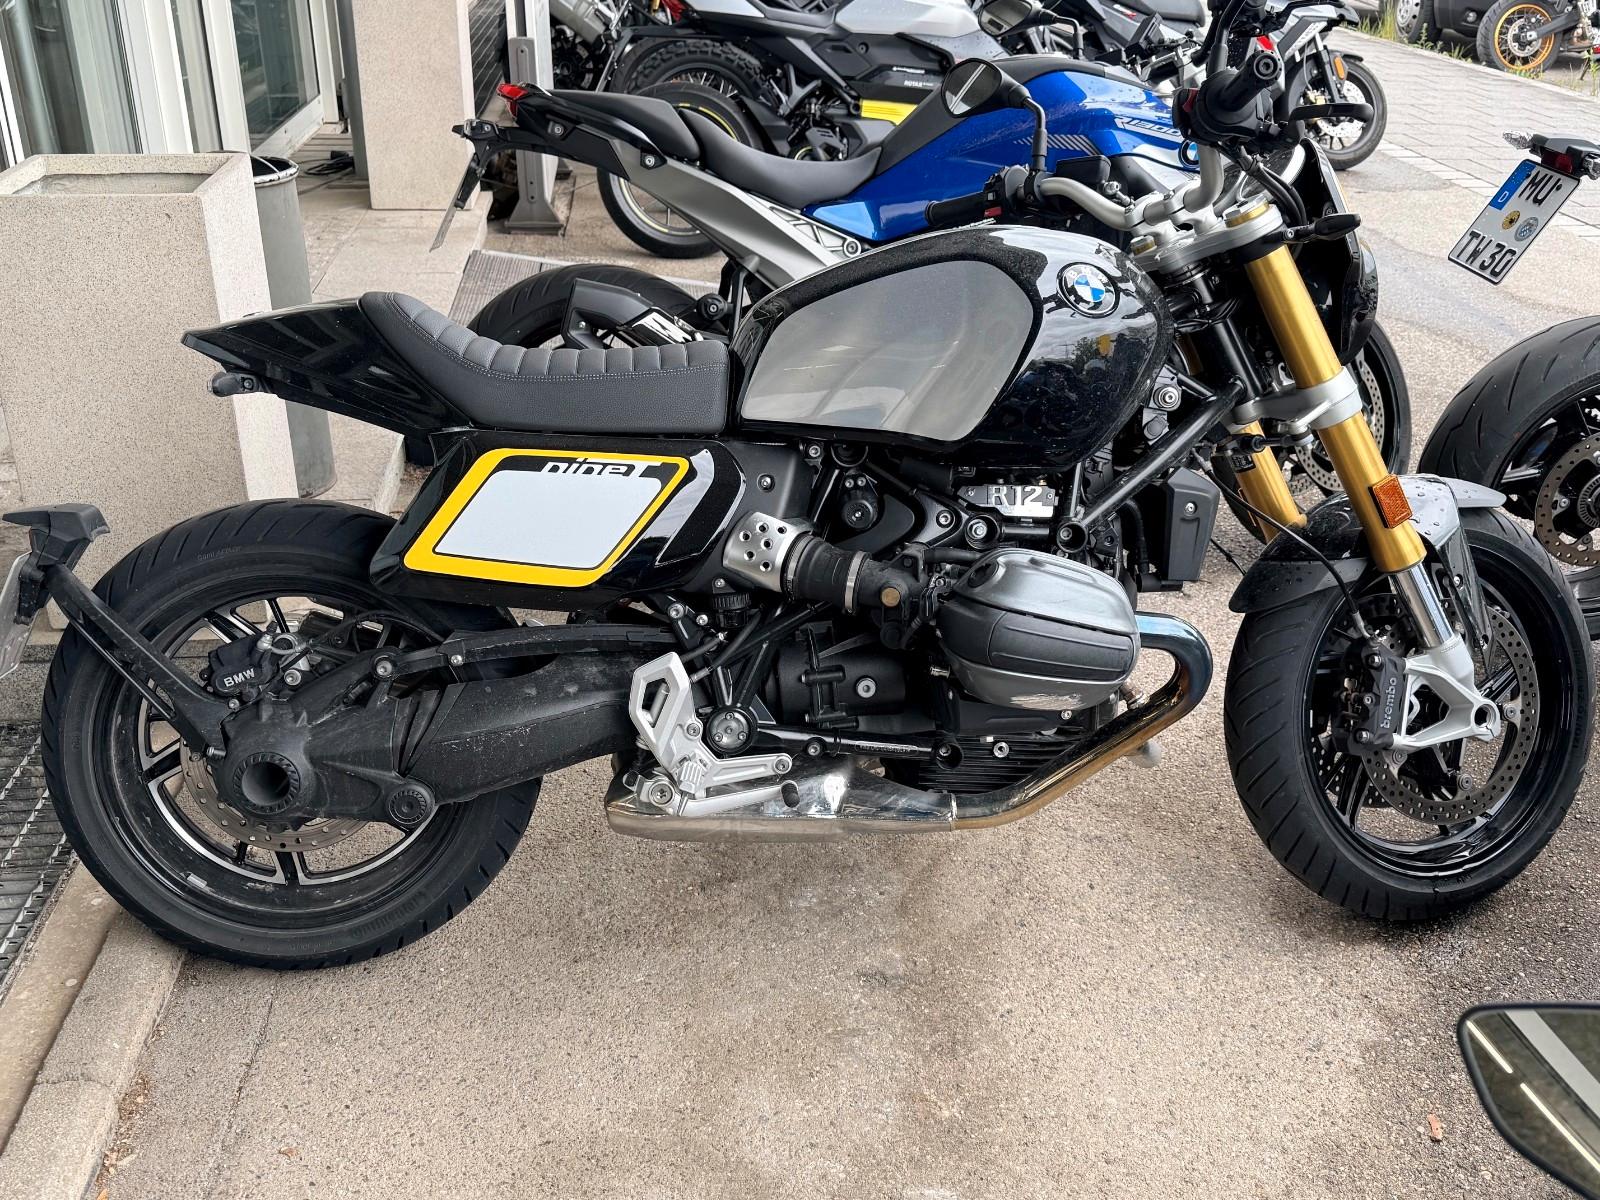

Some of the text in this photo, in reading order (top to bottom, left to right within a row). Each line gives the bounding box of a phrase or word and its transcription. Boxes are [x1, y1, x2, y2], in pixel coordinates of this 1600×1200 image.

[1497, 191, 1509, 203] D
[1518, 170, 1562, 206] MU
[223, 667, 255, 688] BMW
[1380, 677, 1397, 729] brembo
